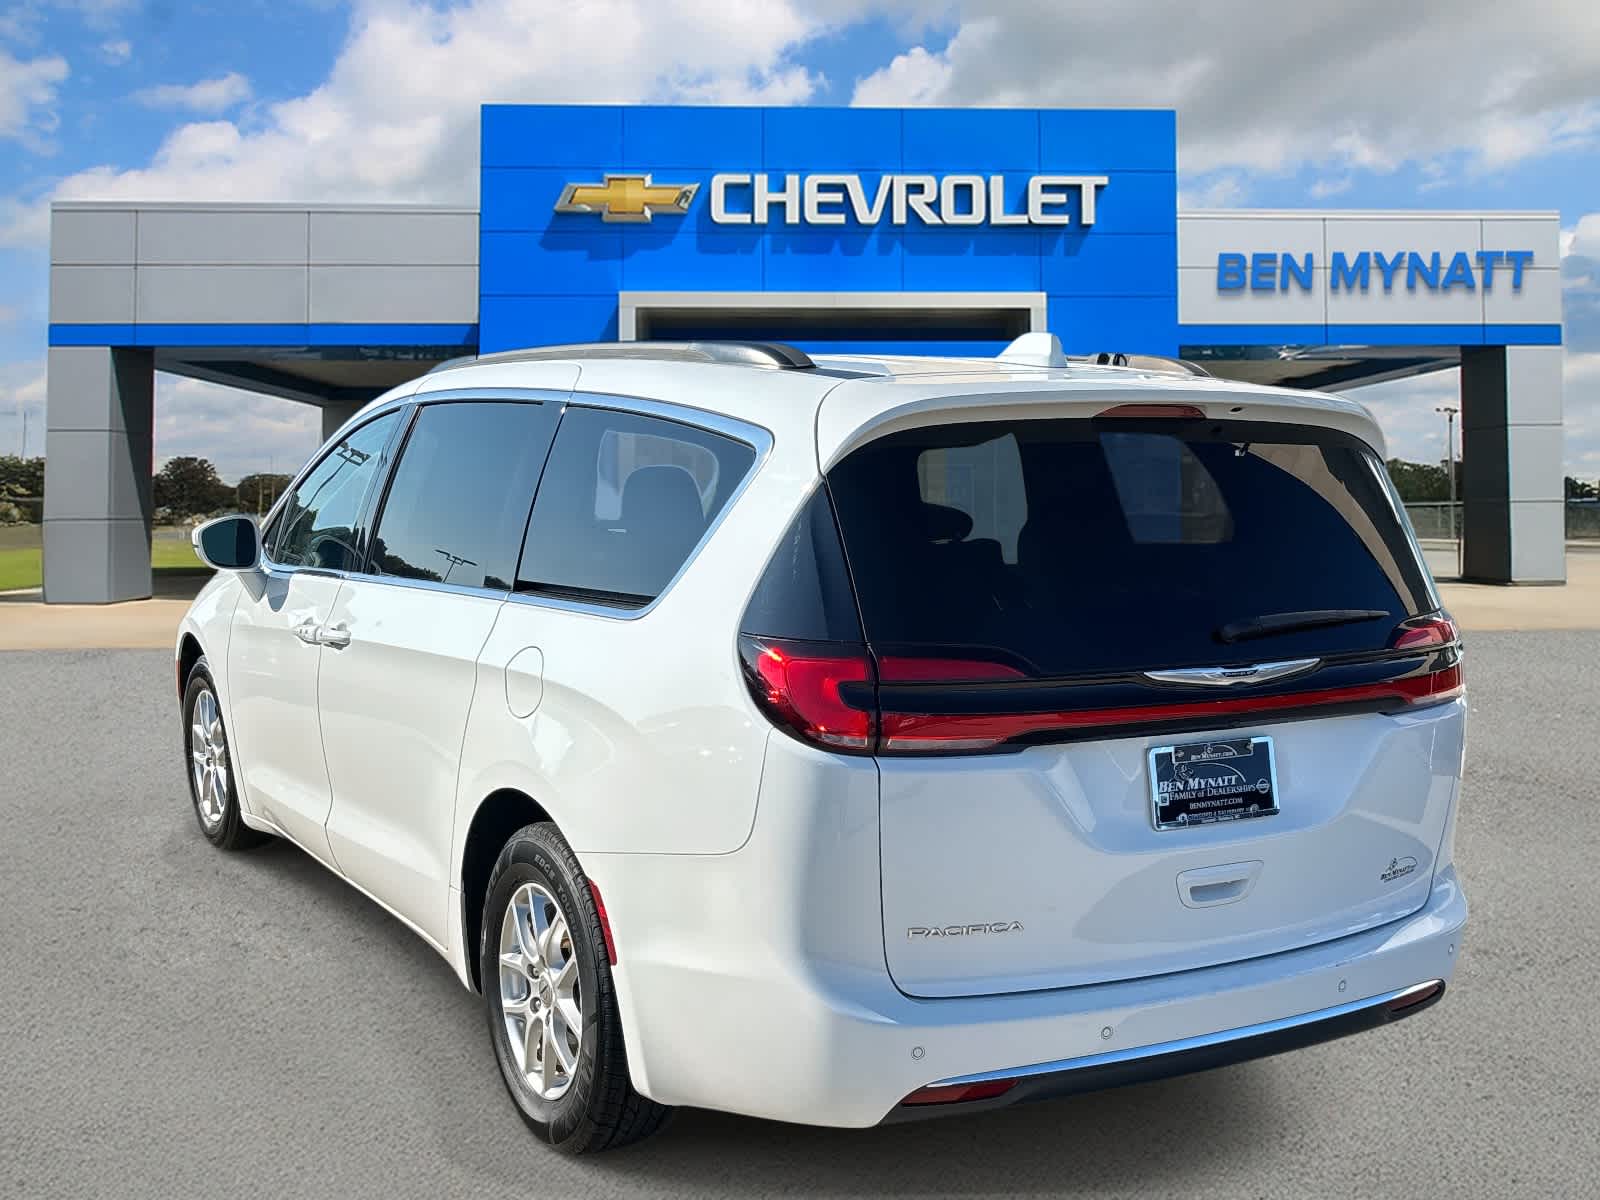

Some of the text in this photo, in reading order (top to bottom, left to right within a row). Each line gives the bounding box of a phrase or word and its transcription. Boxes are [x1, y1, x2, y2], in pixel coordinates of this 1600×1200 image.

[710, 173, 1109, 226] CHEVROLET
[1217, 250, 1534, 291] BEN MYNATT
[1159, 780, 1185, 793] BEN
[1187, 775, 1239, 791] MYNATT
[1169, 789, 1196, 801] FAMILY
[1207, 783, 1257, 797] DEALERSHIPS
[907, 920, 1024, 939] PACIFICA
